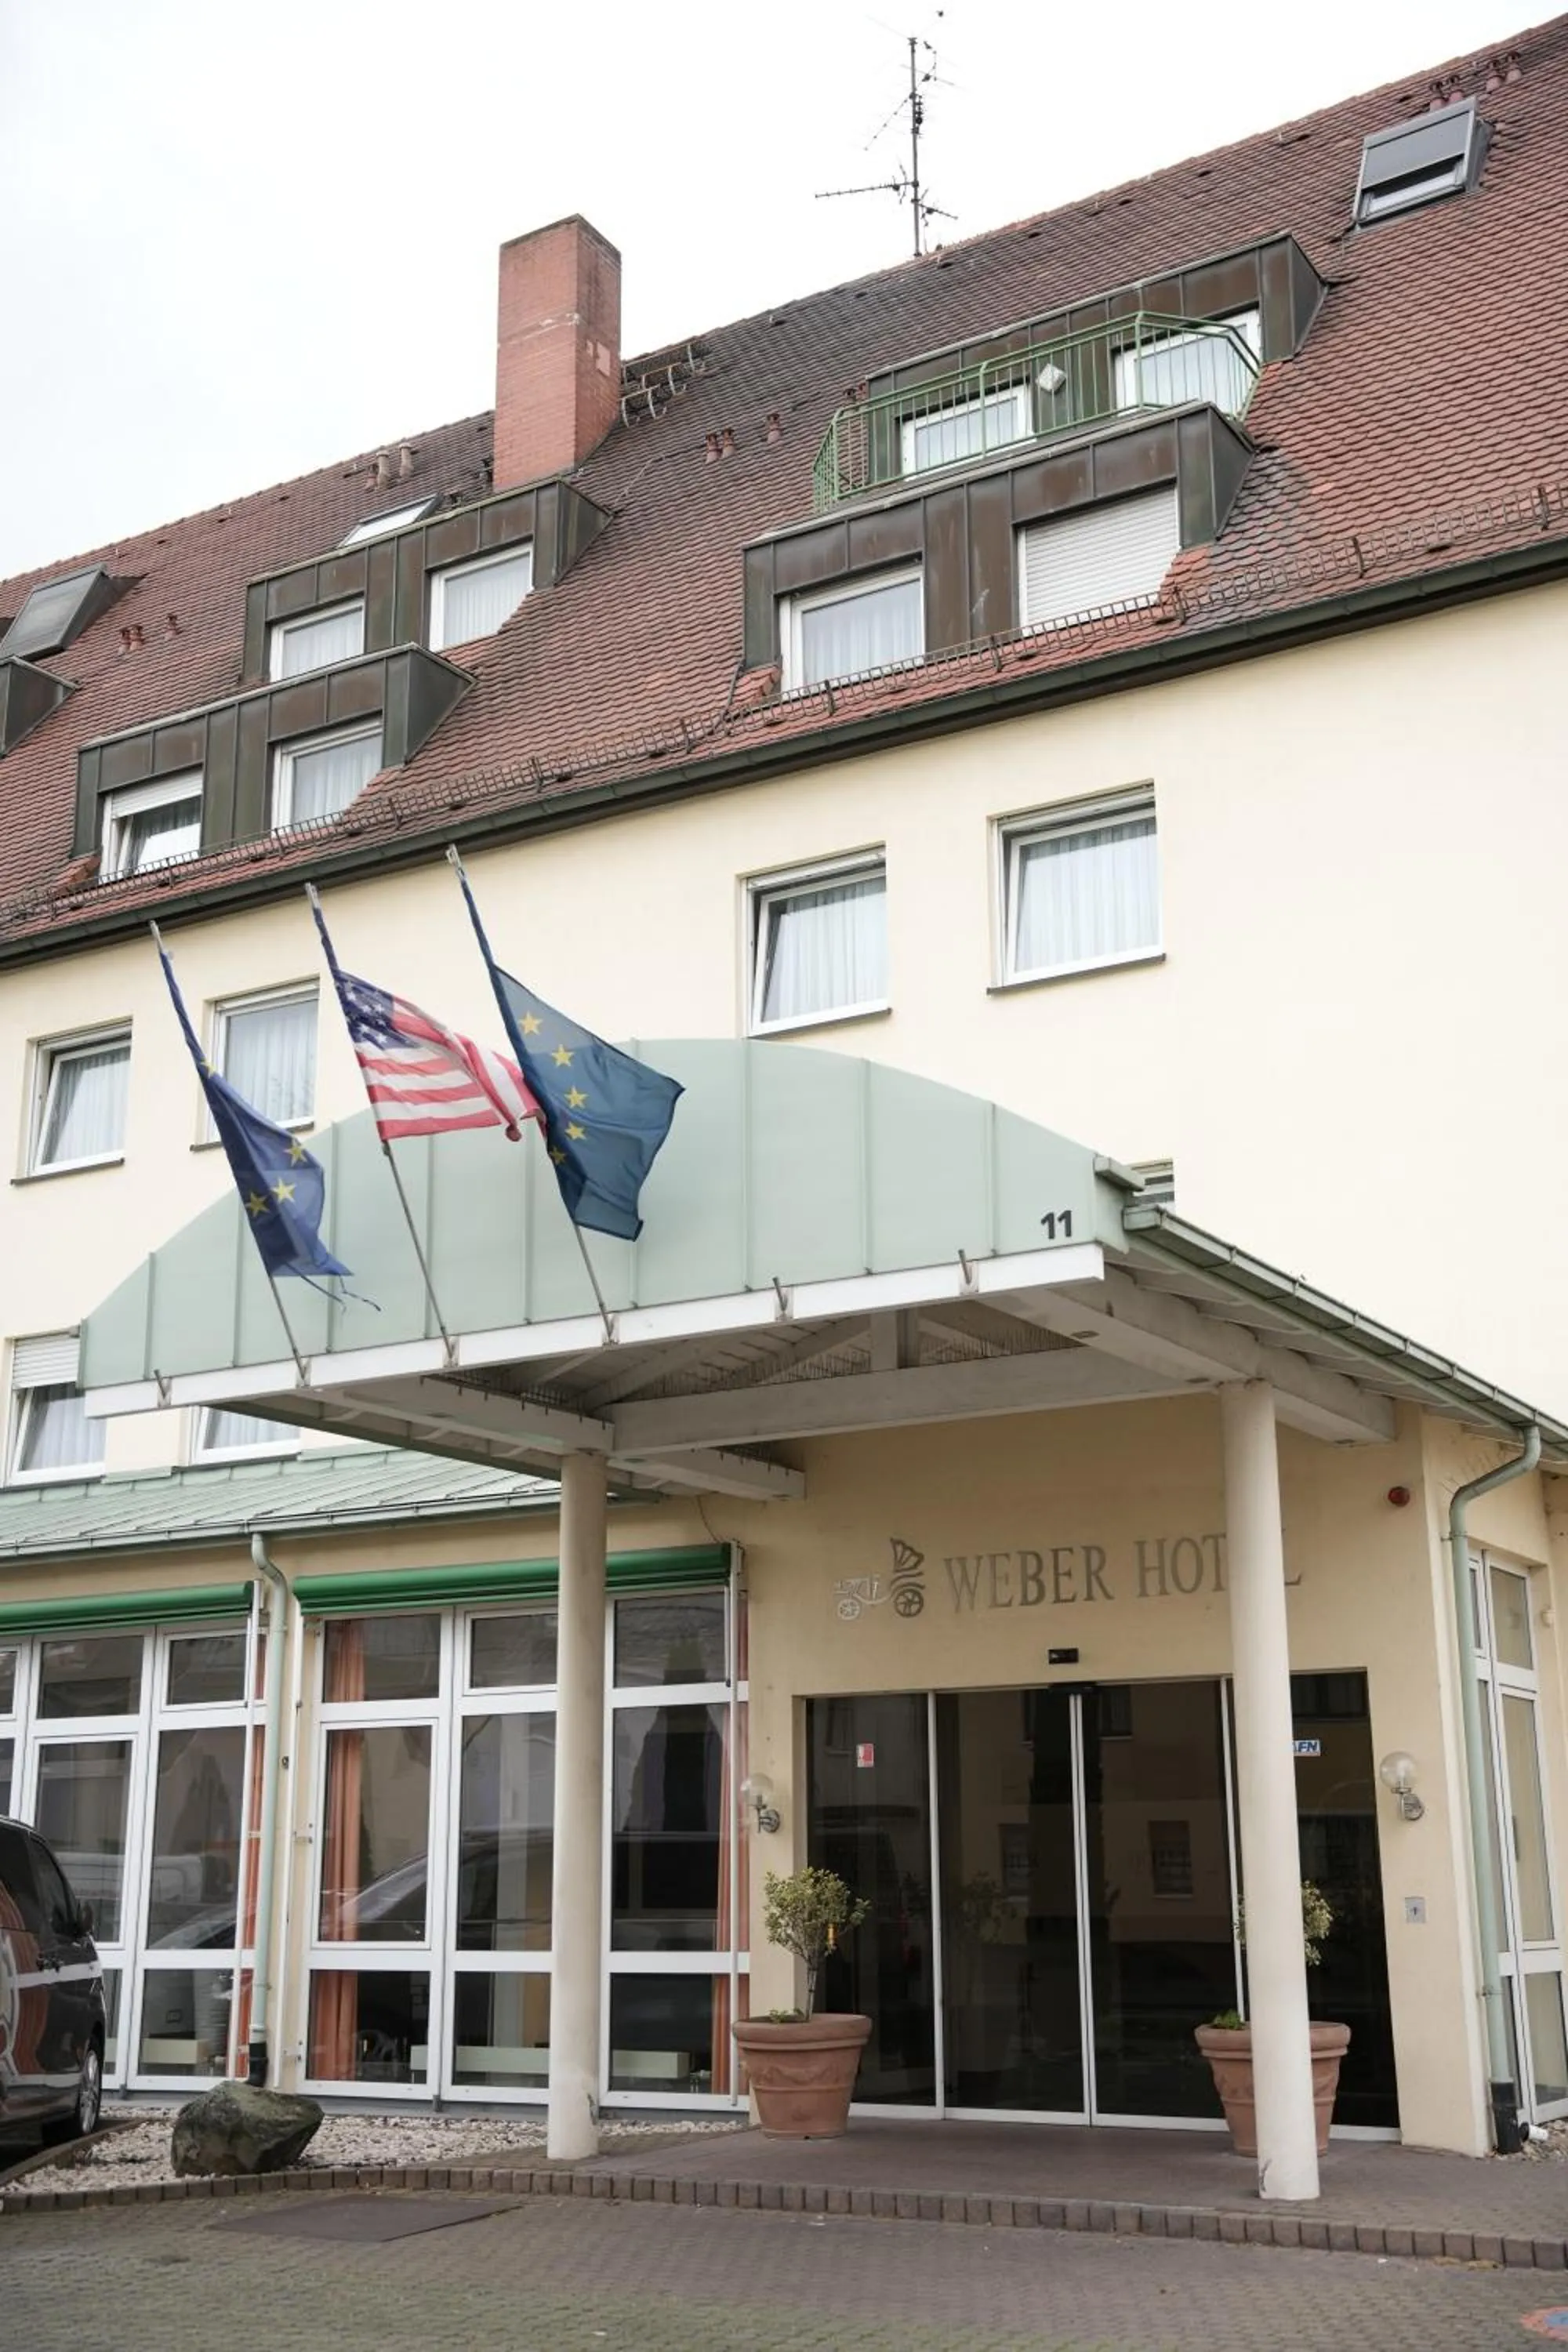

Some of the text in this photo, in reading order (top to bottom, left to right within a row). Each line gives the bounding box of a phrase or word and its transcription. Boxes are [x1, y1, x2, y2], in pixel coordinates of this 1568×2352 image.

[1040, 1210, 1072, 1240] 11
[942, 1528, 1302, 1613] WEBER HOT
